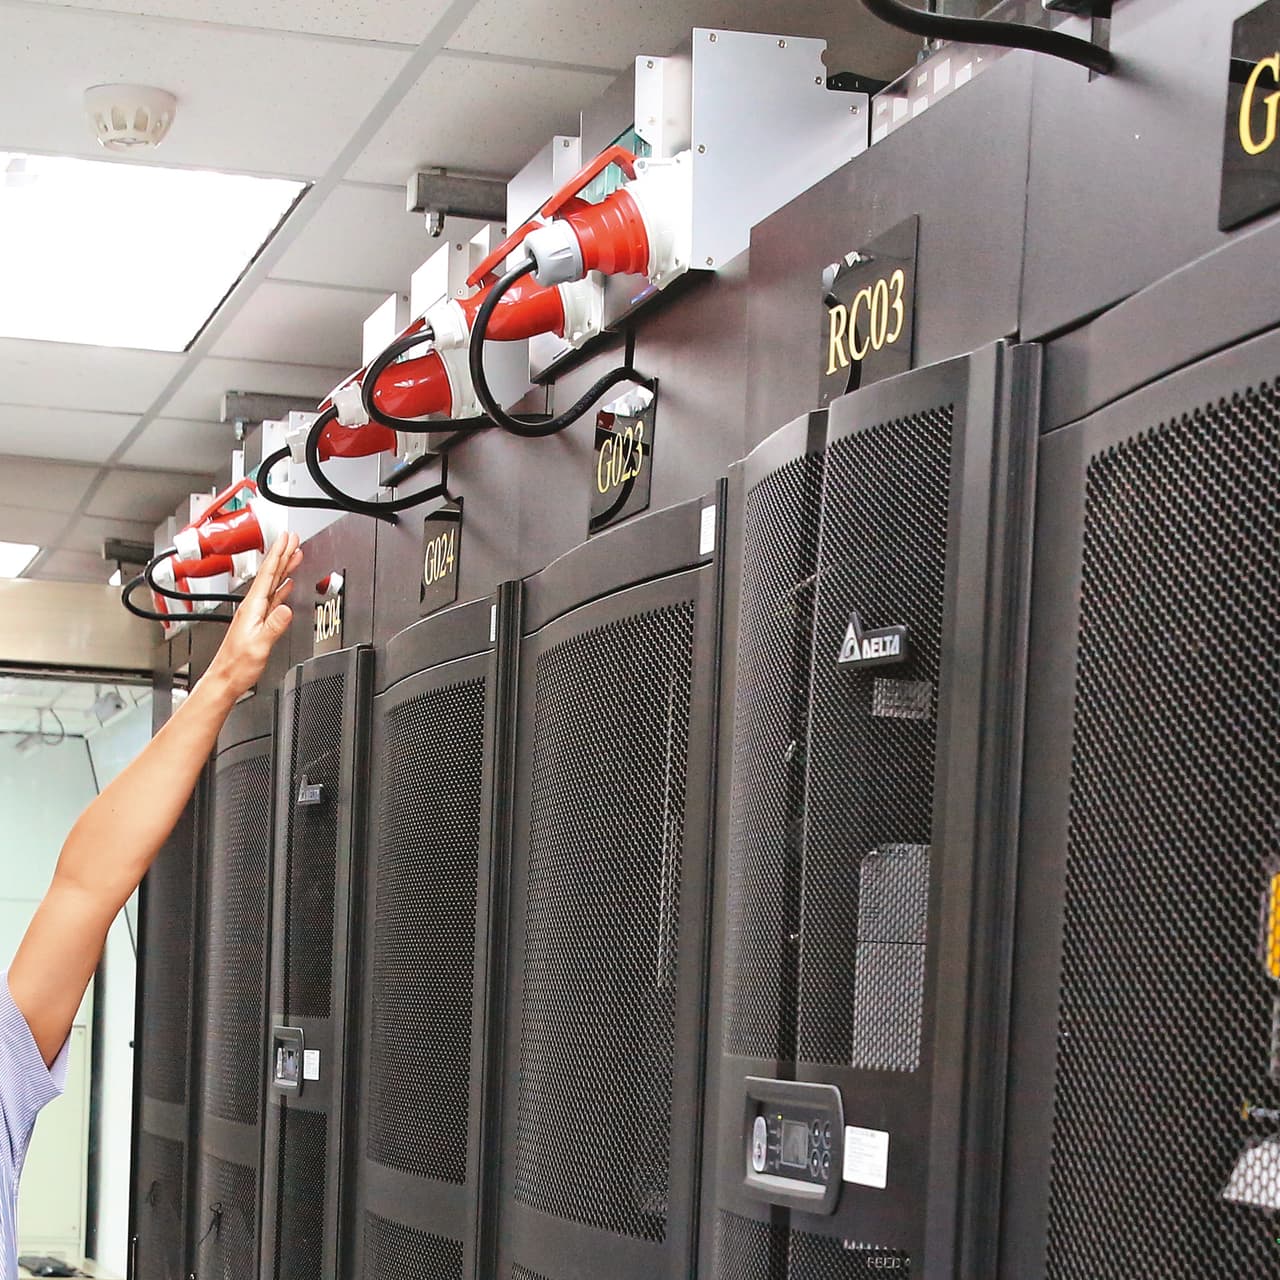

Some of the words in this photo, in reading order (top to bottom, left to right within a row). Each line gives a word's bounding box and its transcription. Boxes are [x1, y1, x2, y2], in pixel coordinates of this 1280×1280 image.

[825, 268, 905, 376] RC03
[597, 420, 644, 494] G023
[424, 527, 455, 586] G024
[315, 595, 341, 643] RC04
[862, 634, 900, 659] DELTA
